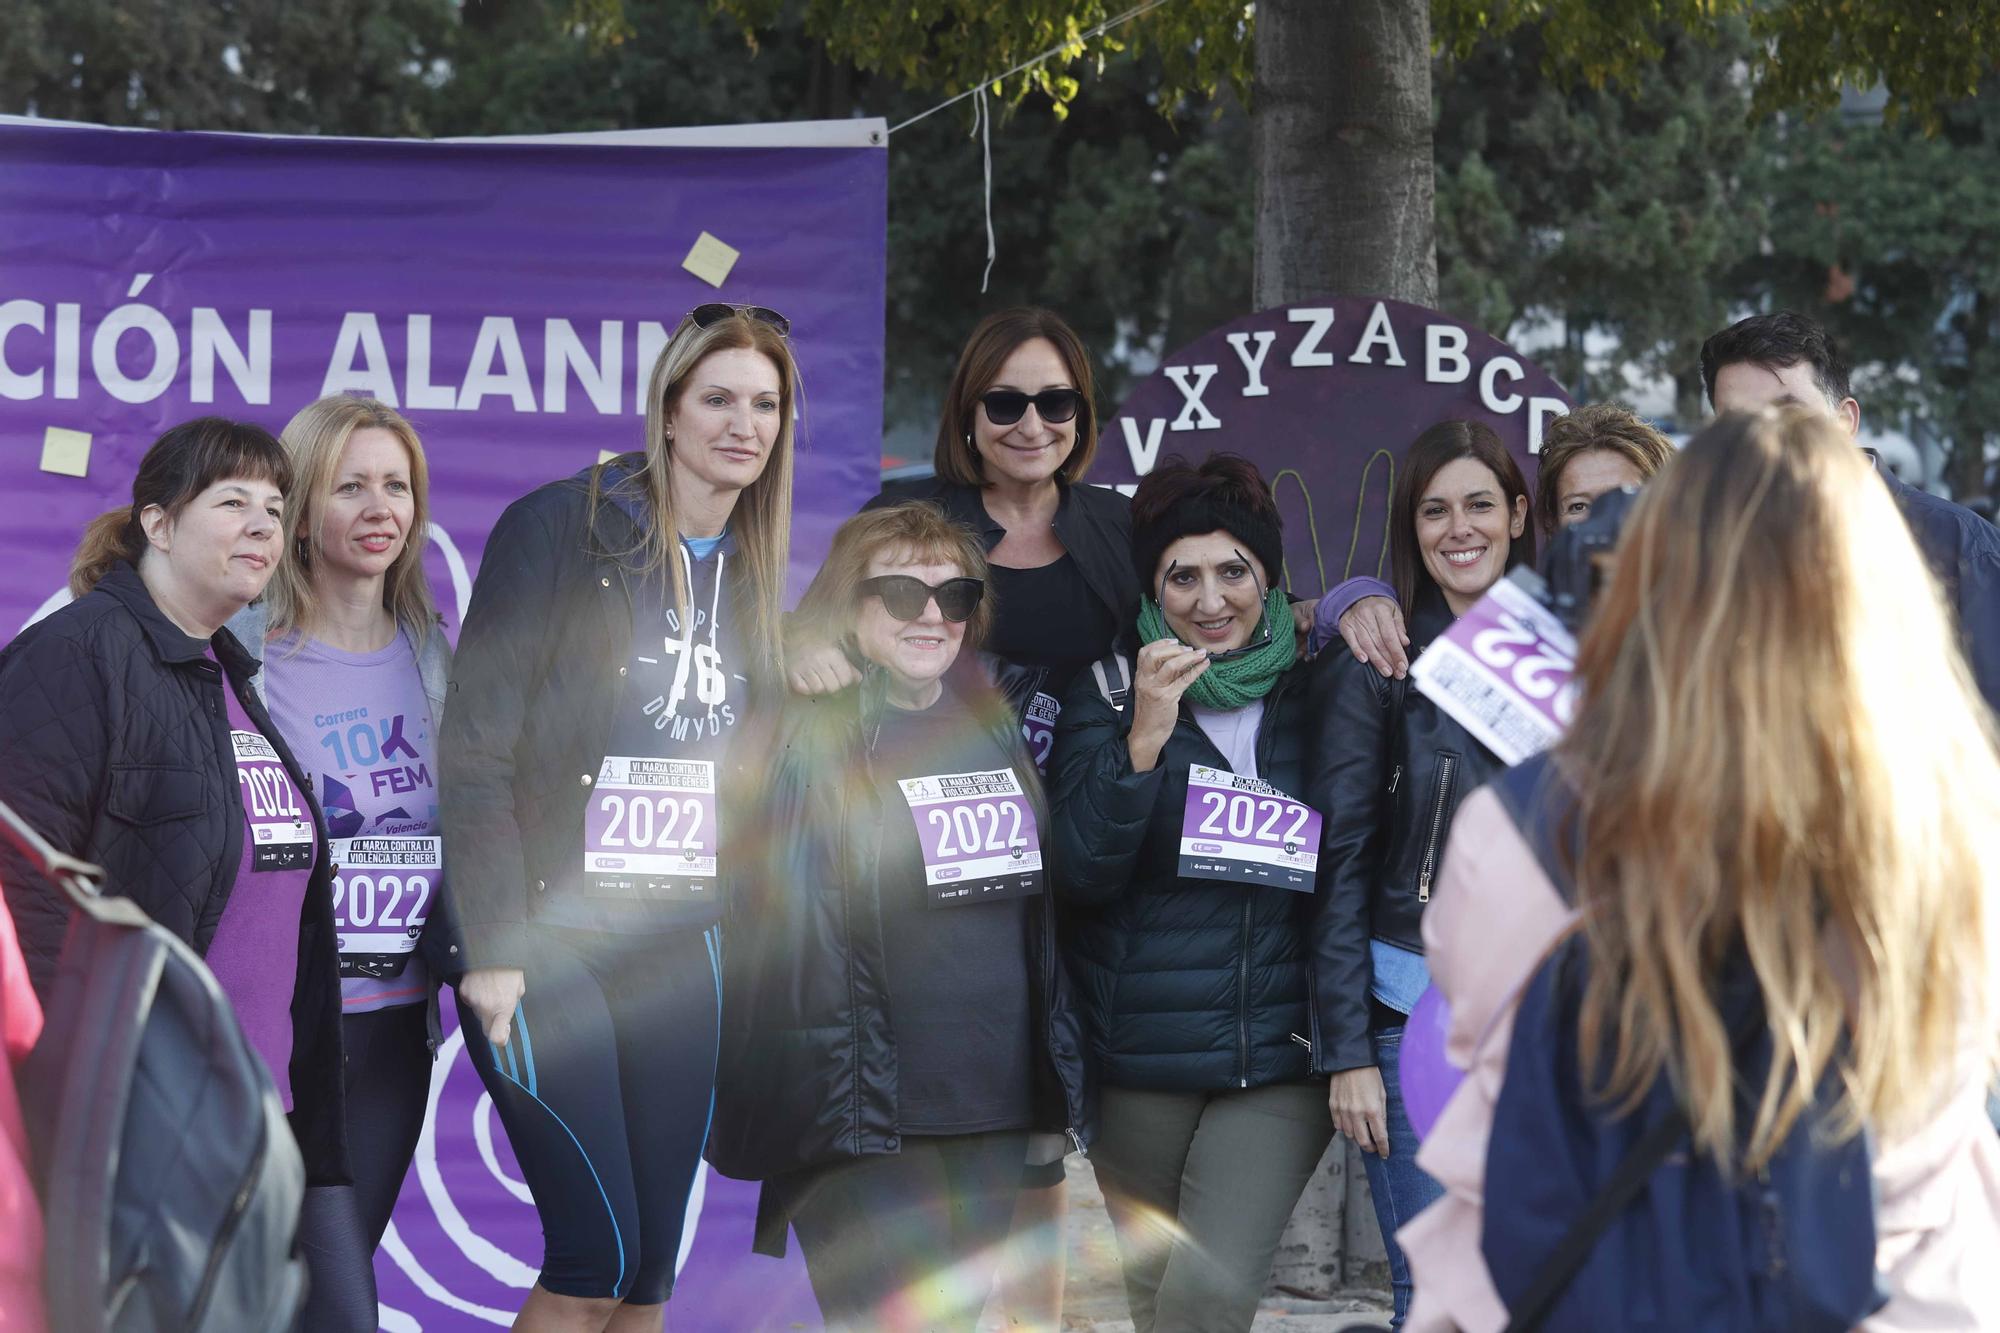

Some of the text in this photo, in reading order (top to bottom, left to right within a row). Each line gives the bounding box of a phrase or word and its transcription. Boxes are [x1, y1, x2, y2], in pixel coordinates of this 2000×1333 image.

[318, 311, 799, 421] ALAN
[314, 707, 368, 728] Carrera
[1031, 695, 1056, 711] ONTRA
[369, 762, 433, 798] FEM
[642, 761, 669, 773] MARXA
[669, 763, 698, 775] CONTRA
[237, 766, 302, 817] 2022
[386, 820, 429, 835] Valencia
[600, 795, 704, 850] 2022
[928, 800, 1028, 858] 2022
[1199, 791, 1310, 846] 2022
[362, 840, 388, 851] MARXA
[390, 840, 421, 851] CONTRA
[423, 841, 434, 852] LA
[392, 854, 402, 864] DE
[331, 875, 430, 927] 2022
